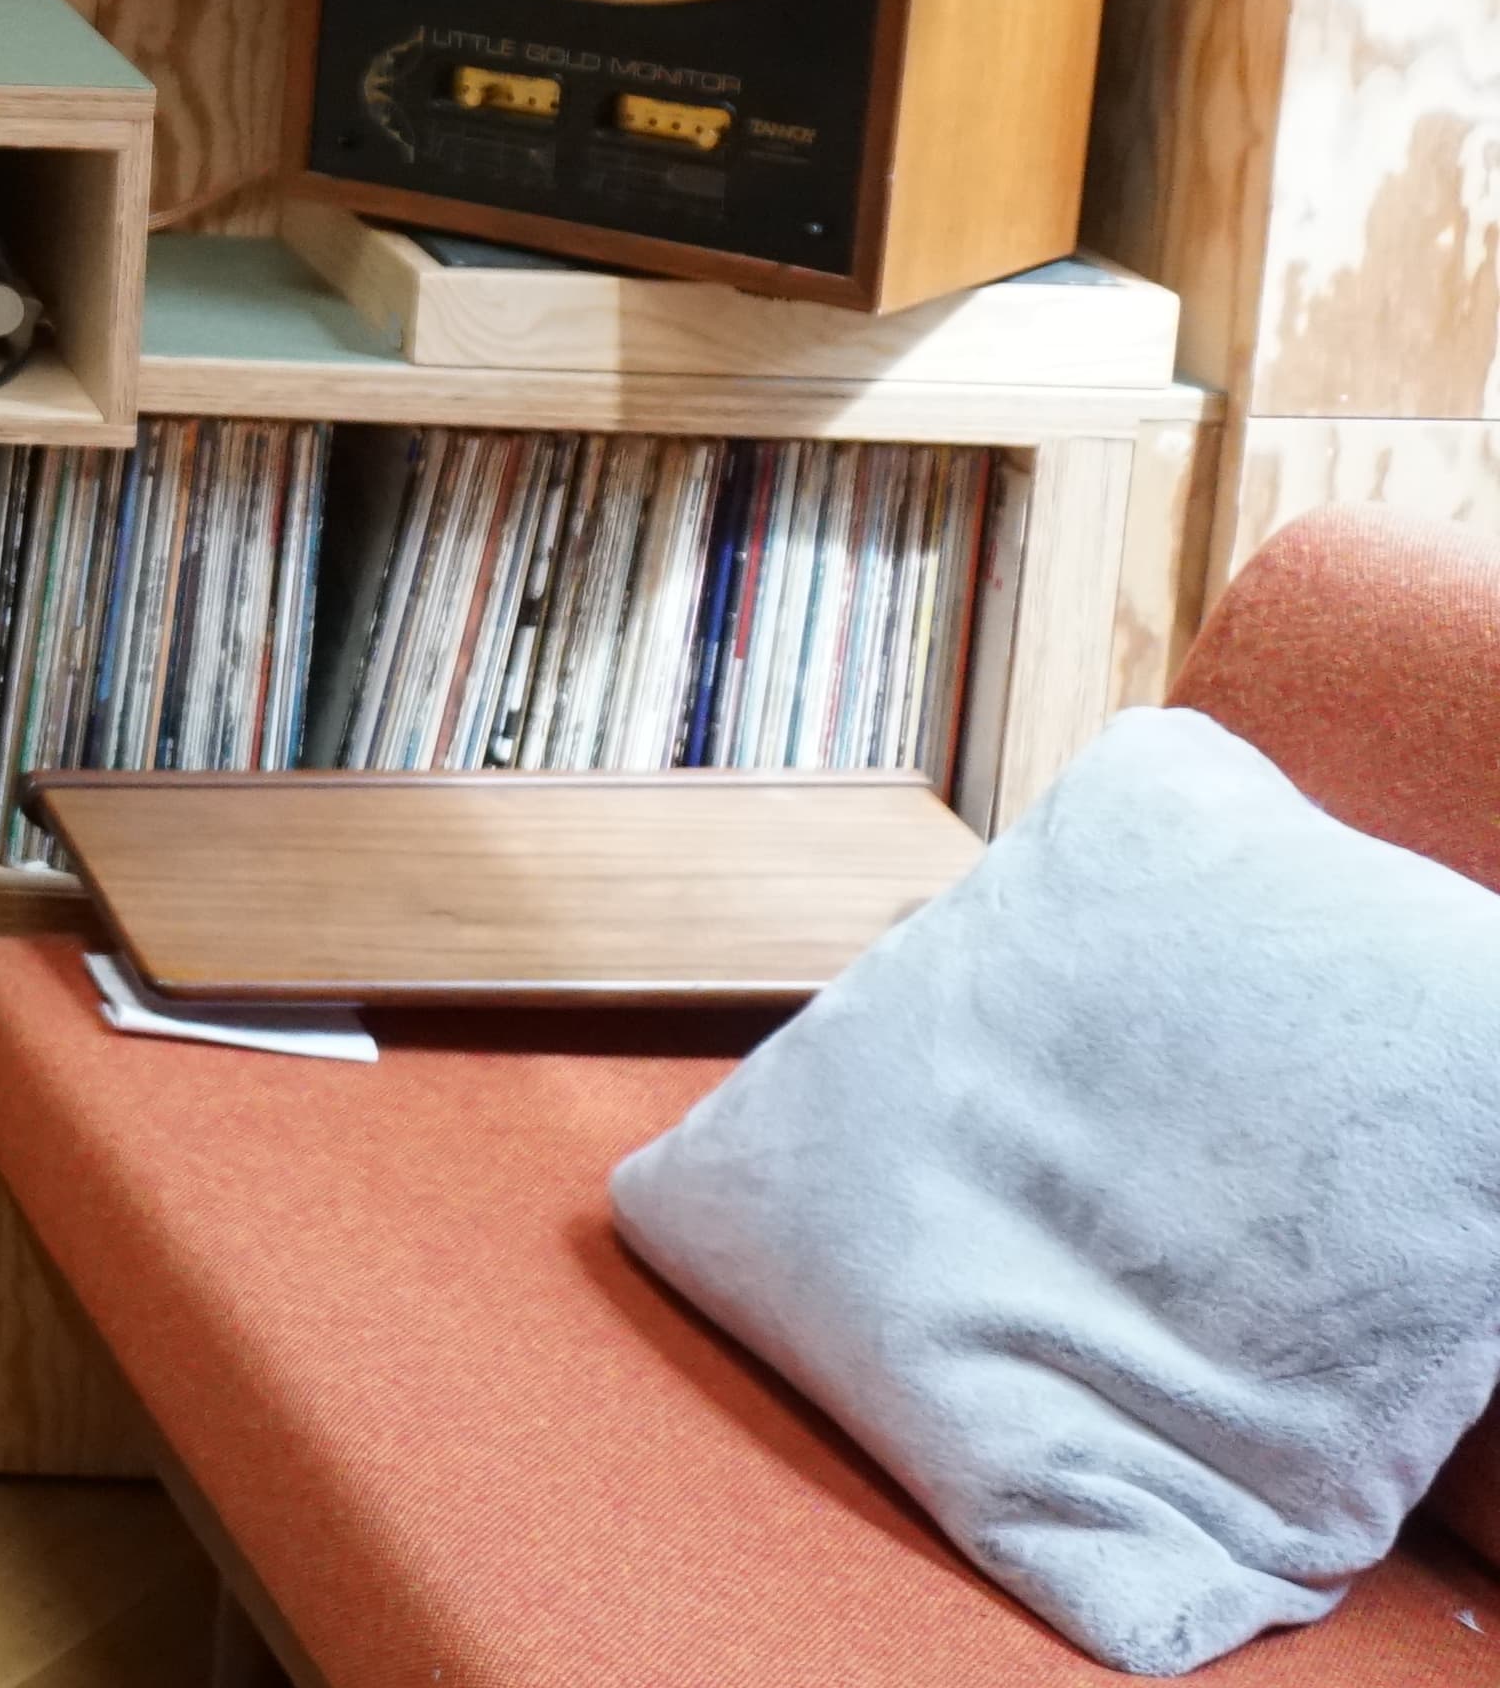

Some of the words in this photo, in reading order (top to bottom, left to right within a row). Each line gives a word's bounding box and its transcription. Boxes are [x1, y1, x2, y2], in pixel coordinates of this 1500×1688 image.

[433, 29, 516, 57] LITTLE
[526, 44, 600, 72] GOLD
[610, 57, 742, 94] MONITOR
